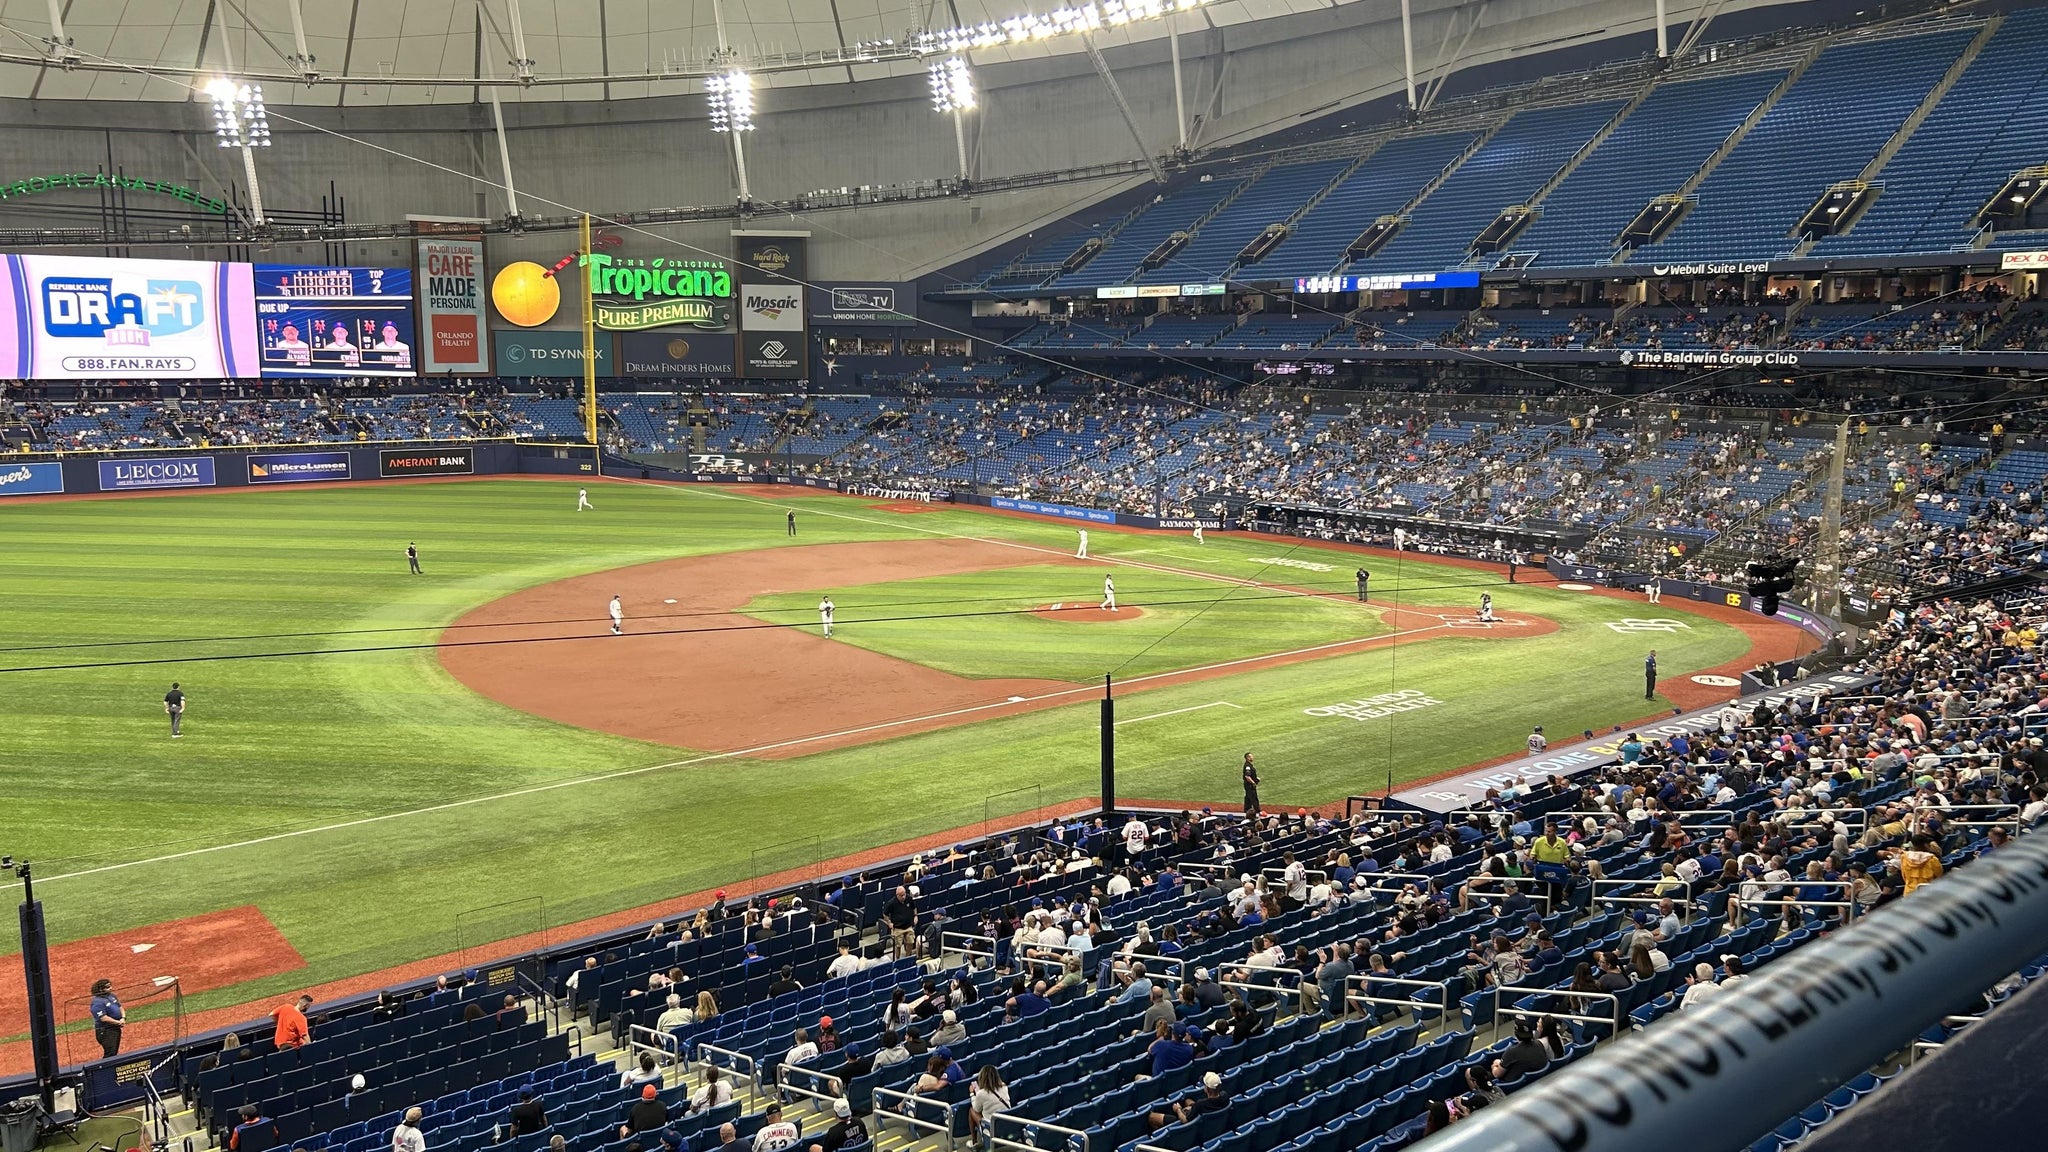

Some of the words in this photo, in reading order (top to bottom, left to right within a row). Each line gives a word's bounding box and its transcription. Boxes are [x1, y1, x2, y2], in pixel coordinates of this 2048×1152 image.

[0, 172, 147, 200] TROPICANA
[155, 179, 226, 214] FIELD
[427, 245, 450, 254] MAJOR
[451, 246, 473, 254] LEAGUE
[753, 252, 771, 261] Hard
[772, 253, 790, 263] Rock
[2004, 255, 2031, 263] DEX
[428, 254, 474, 277] CARE
[669, 260, 725, 268] ORIGINAL
[1670, 264, 1705, 275] Webull
[1707, 263, 1736, 274] Suite
[1738, 261, 1769, 273] Level
[369, 270, 384, 279] TOP
[579, 253, 731, 300] Tropicana
[48, 283, 85, 291] REPUBLIC
[330, 278, 335, 286] 2
[342, 278, 348, 286] 2
[372, 279, 382, 294] 2
[429, 277, 476, 297] MADE
[430, 298, 476, 309] PERSONAL
[746, 295, 798, 309] Mosaic
[49, 292, 197, 326] DRAFT
[260, 304, 276, 313] DUE
[277, 303, 290, 313] UP
[599, 308, 639, 325] PURE
[642, 304, 713, 322] PREMIUM
[436, 331, 473, 339] ORLANDO
[441, 339, 470, 347] HEALTH
[530, 349, 547, 359] TD
[1637, 352, 1661, 363] The
[1663, 352, 1718, 364] Baldwin
[1720, 353, 1763, 366] Group
[1765, 353, 1798, 364] Club
[77, 358, 182, 369] 888.FAN.RAYS
[626, 363, 660, 373] DREAM
[661, 363, 698, 373] FINDERS
[700, 363, 731, 373] HOMES
[272, 463, 347, 471] MicroLumen
[389, 457, 439, 468] AMERANT
[440, 456, 465, 466] BANK
[1160, 520, 1196, 528] RAYMON
[1303, 689, 1425, 717] ORLANDO
[1338, 696, 1444, 721] HEALTH
[1645, 725, 1688, 737] TO
[1131, 830, 1143, 840] 22
[763, 1128, 794, 1141] CAMINERO
